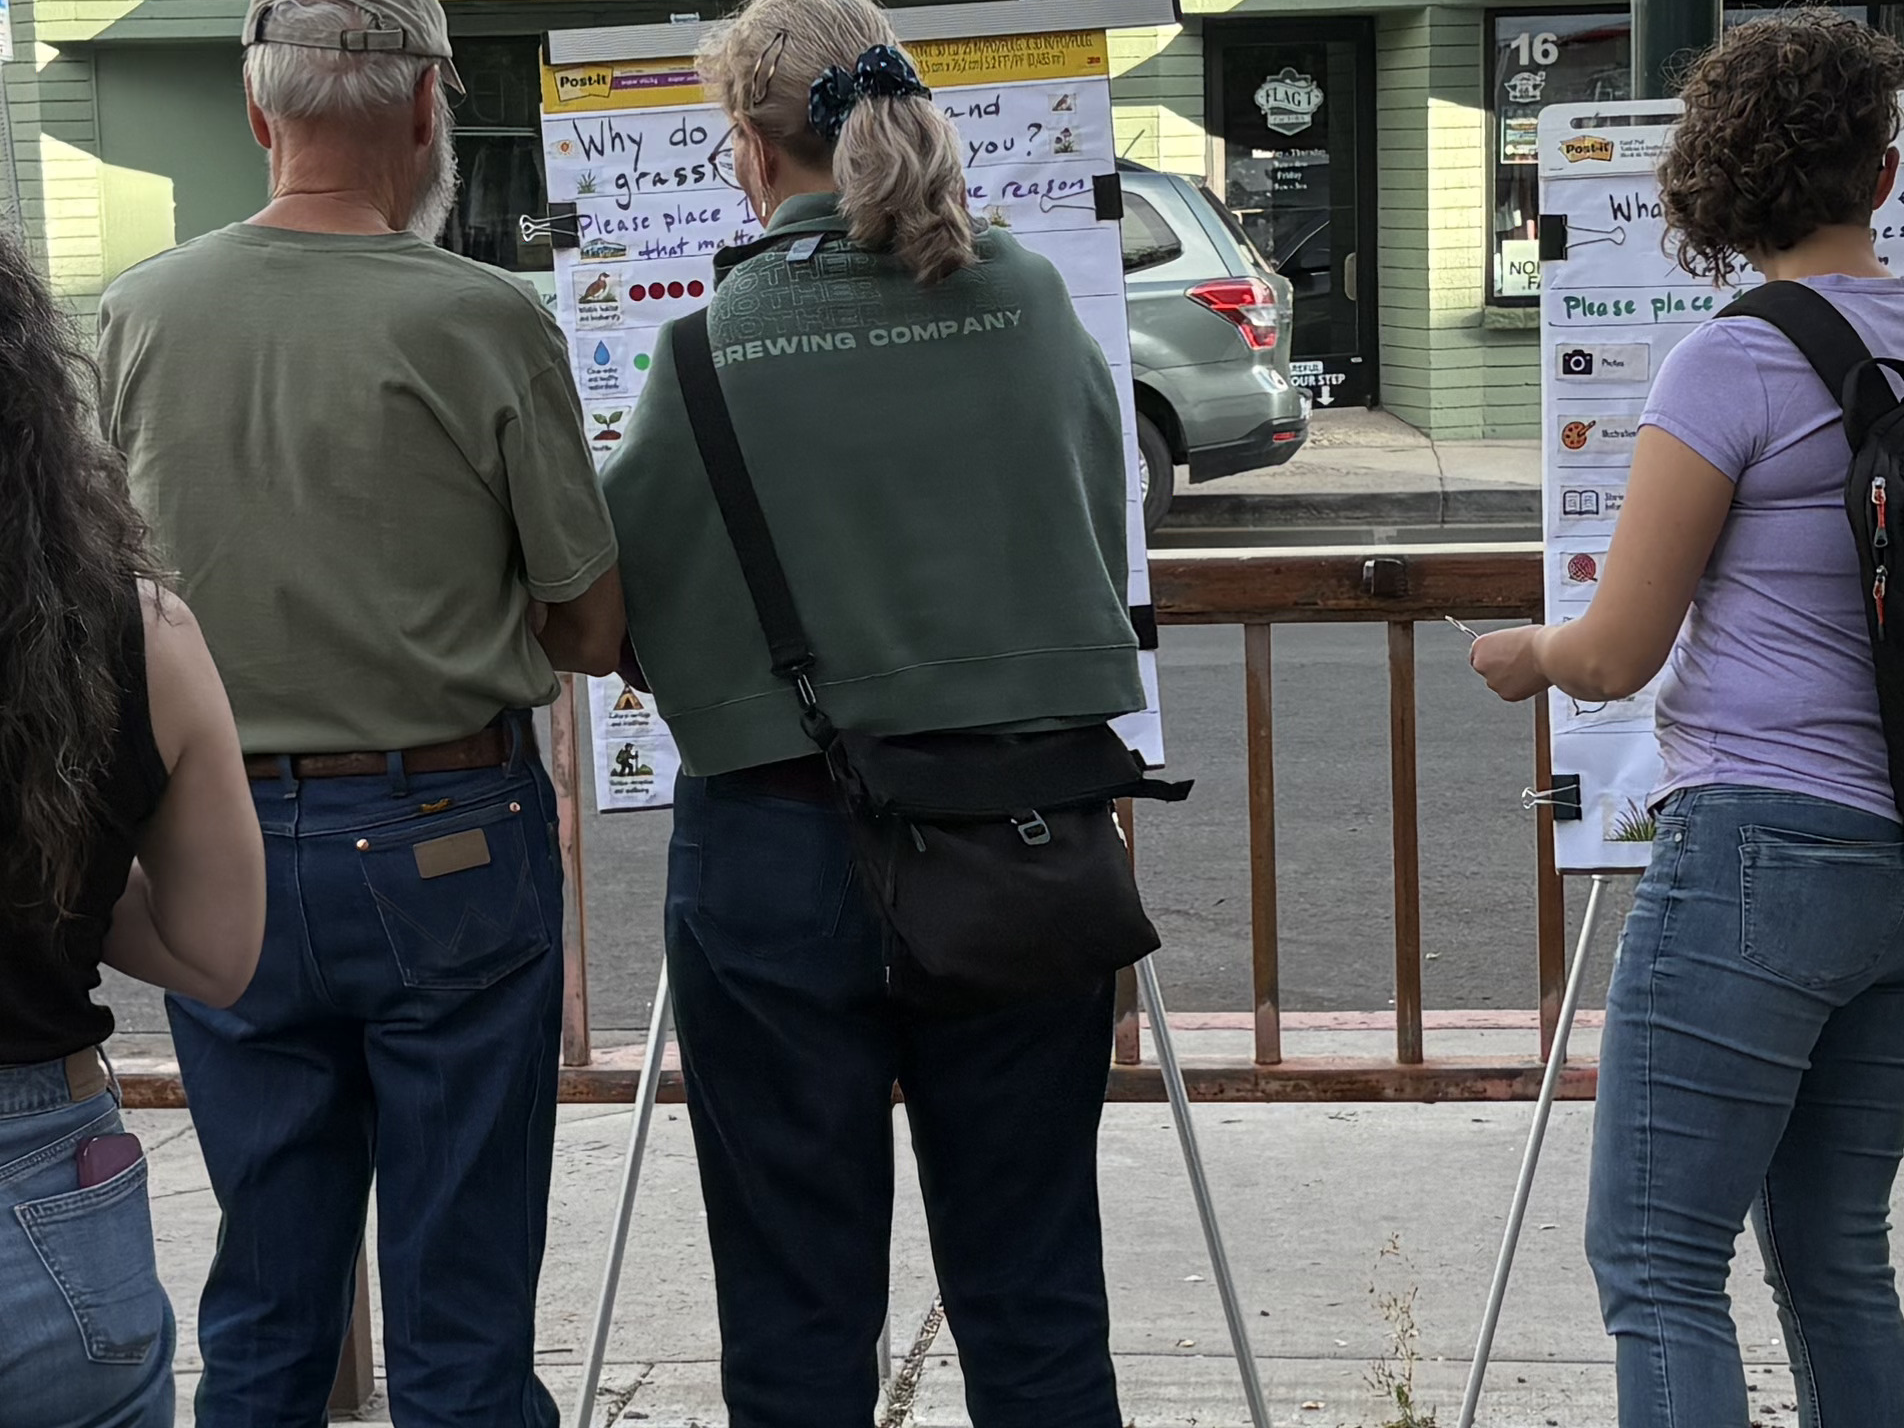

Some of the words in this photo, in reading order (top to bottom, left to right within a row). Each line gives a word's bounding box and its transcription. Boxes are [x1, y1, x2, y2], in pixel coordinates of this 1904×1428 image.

[1510, 32, 1559, 66] 16
[559, 72, 608, 89] Post-it
[1266, 87, 1301, 107] FLAG
[1305, 90, 1313, 106] T
[572, 116, 643, 174] Why
[669, 116, 708, 148] do
[1565, 142, 1609, 155] Post-it
[615, 162, 718, 211] grassl
[577, 213, 650, 239] Please
[663, 204, 722, 233] place
[1001, 179, 1085, 200] reason
[1609, 192, 1663, 222] Wha
[638, 239, 689, 262] that
[697, 229, 765, 252] matte
[1509, 260, 1540, 276] NO
[1563, 295, 1636, 320] Please
[1651, 291, 1714, 324] place
[712, 331, 857, 369] BREWING
[869, 308, 1022, 347] COMPANY
[1317, 373, 1346, 385] STEP
